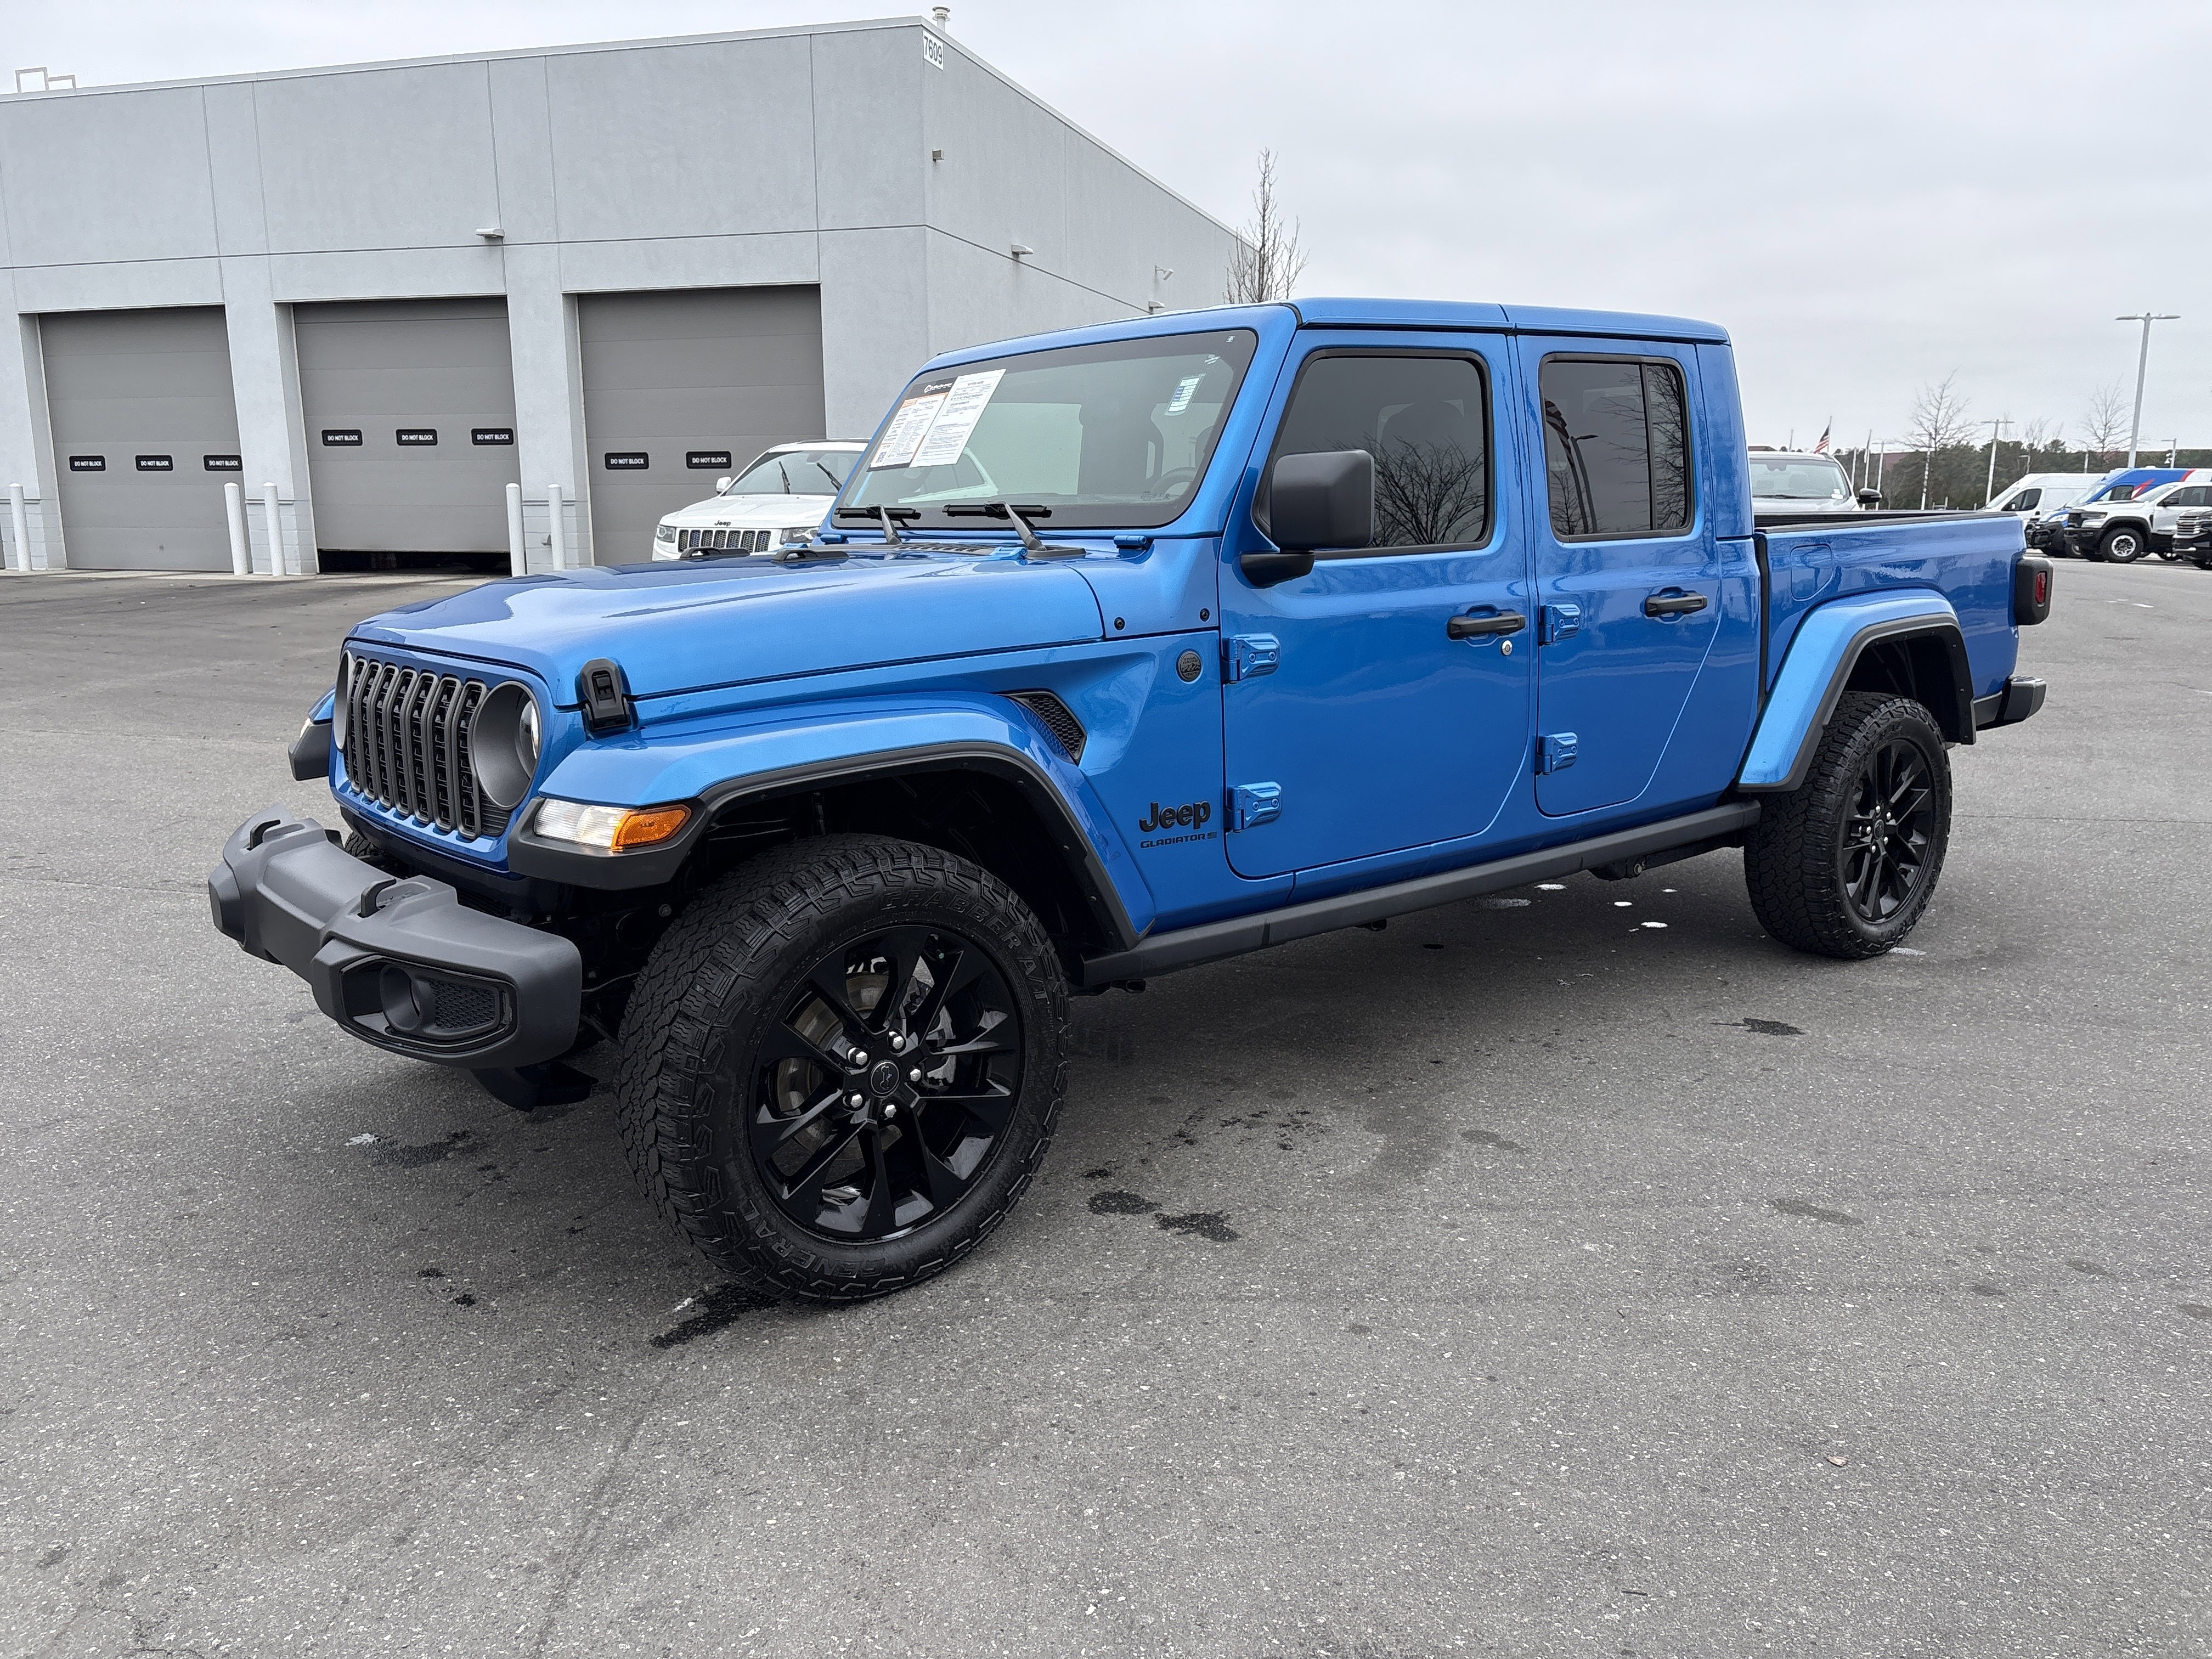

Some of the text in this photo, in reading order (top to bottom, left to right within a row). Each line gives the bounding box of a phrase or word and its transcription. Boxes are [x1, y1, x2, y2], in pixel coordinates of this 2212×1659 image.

[924, 35, 943, 65] 7609
[1138, 800, 1211, 833] Jeep
[1140, 833, 1206, 849] GLADIATOR
[743, 1198, 886, 1279] GENERAL
